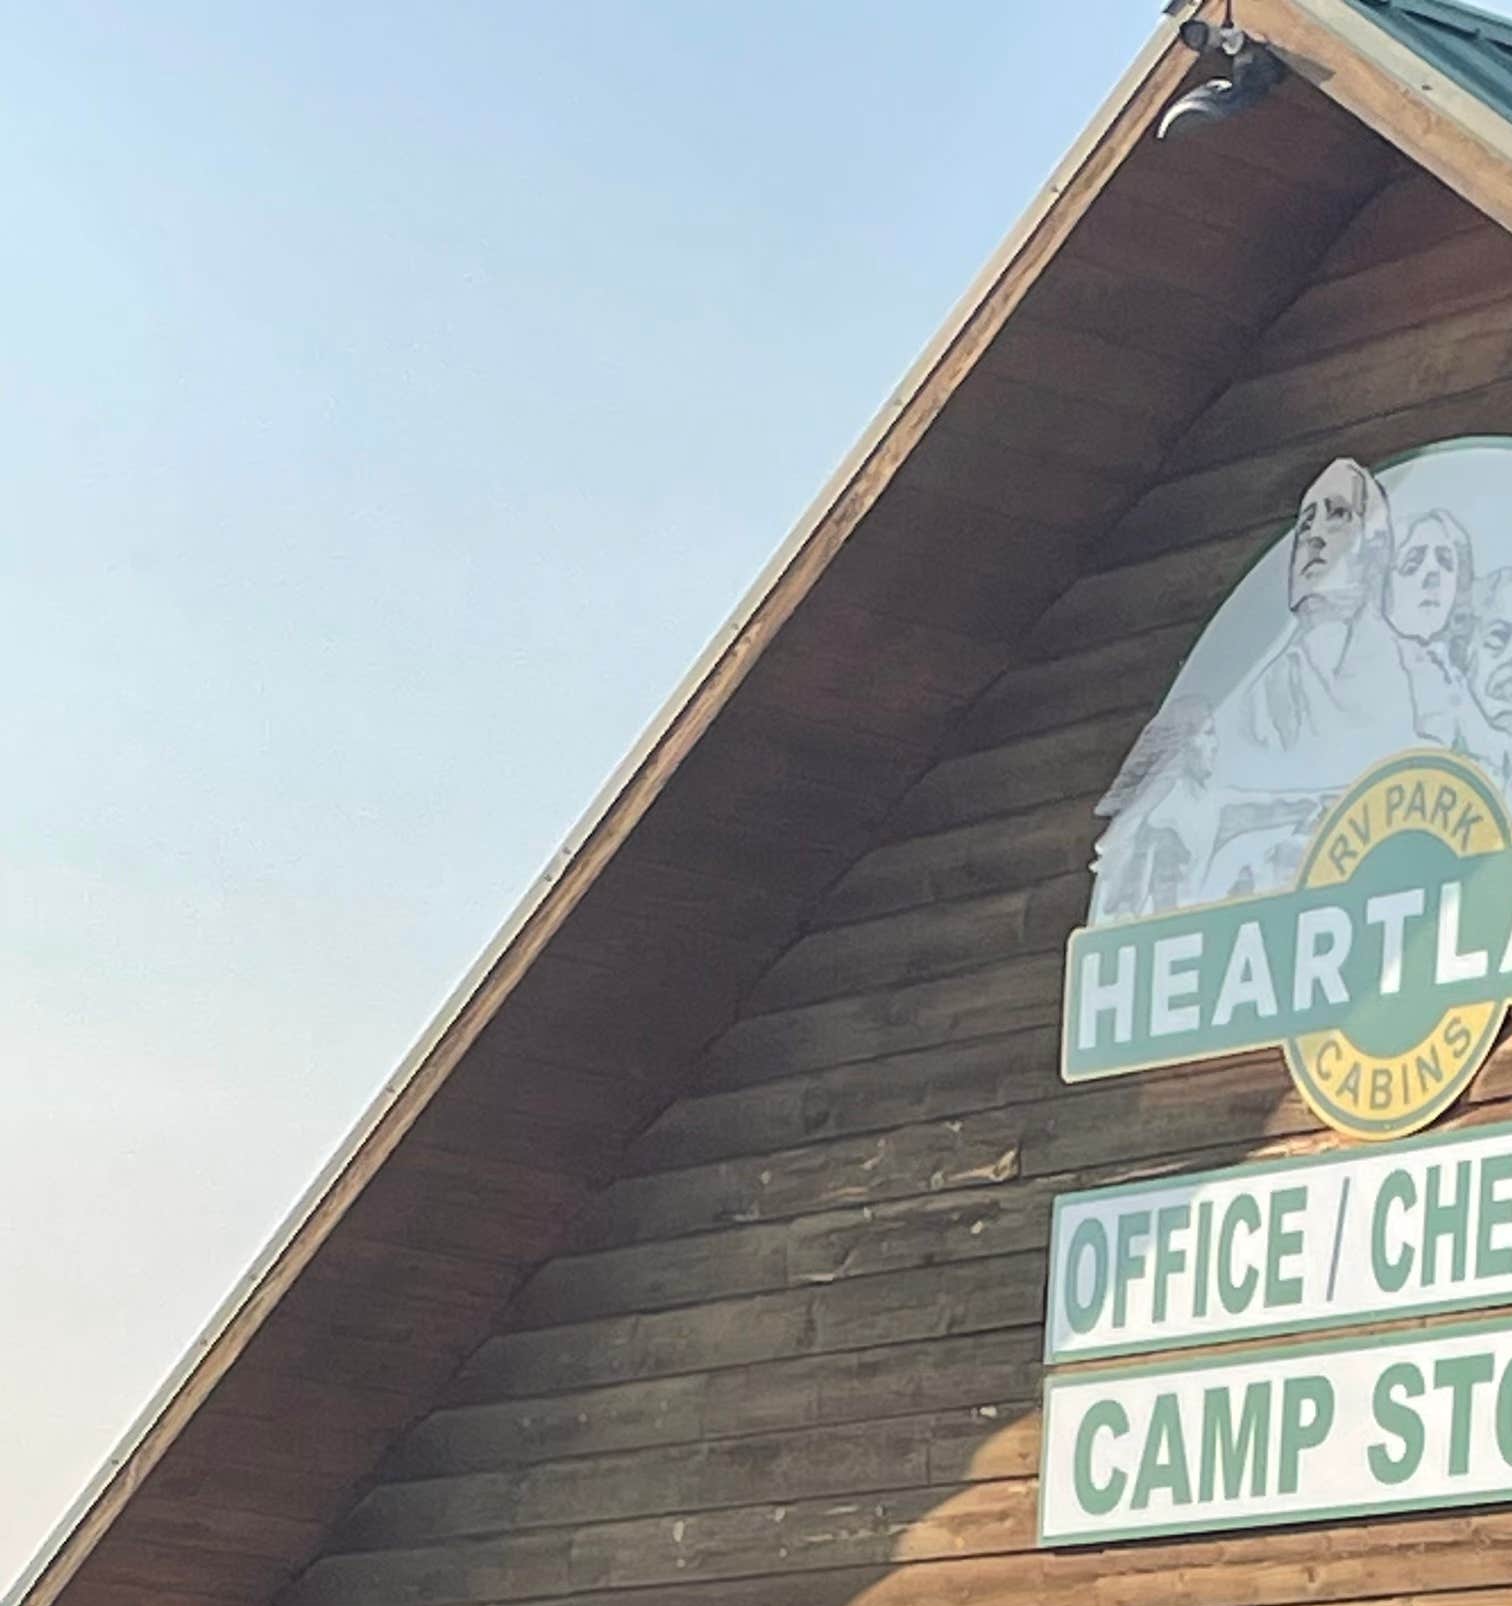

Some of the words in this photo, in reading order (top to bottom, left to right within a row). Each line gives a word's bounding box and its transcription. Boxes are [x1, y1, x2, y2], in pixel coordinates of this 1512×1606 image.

[1328, 803, 1371, 876] RV
[1385, 781, 1483, 852] PARK
[1315, 1016, 1472, 1110] CABINS
[1064, 1186, 1309, 1335] OFFICE
[1326, 1177, 1351, 1301] /
[1073, 1375, 1335, 1516] CAMP
